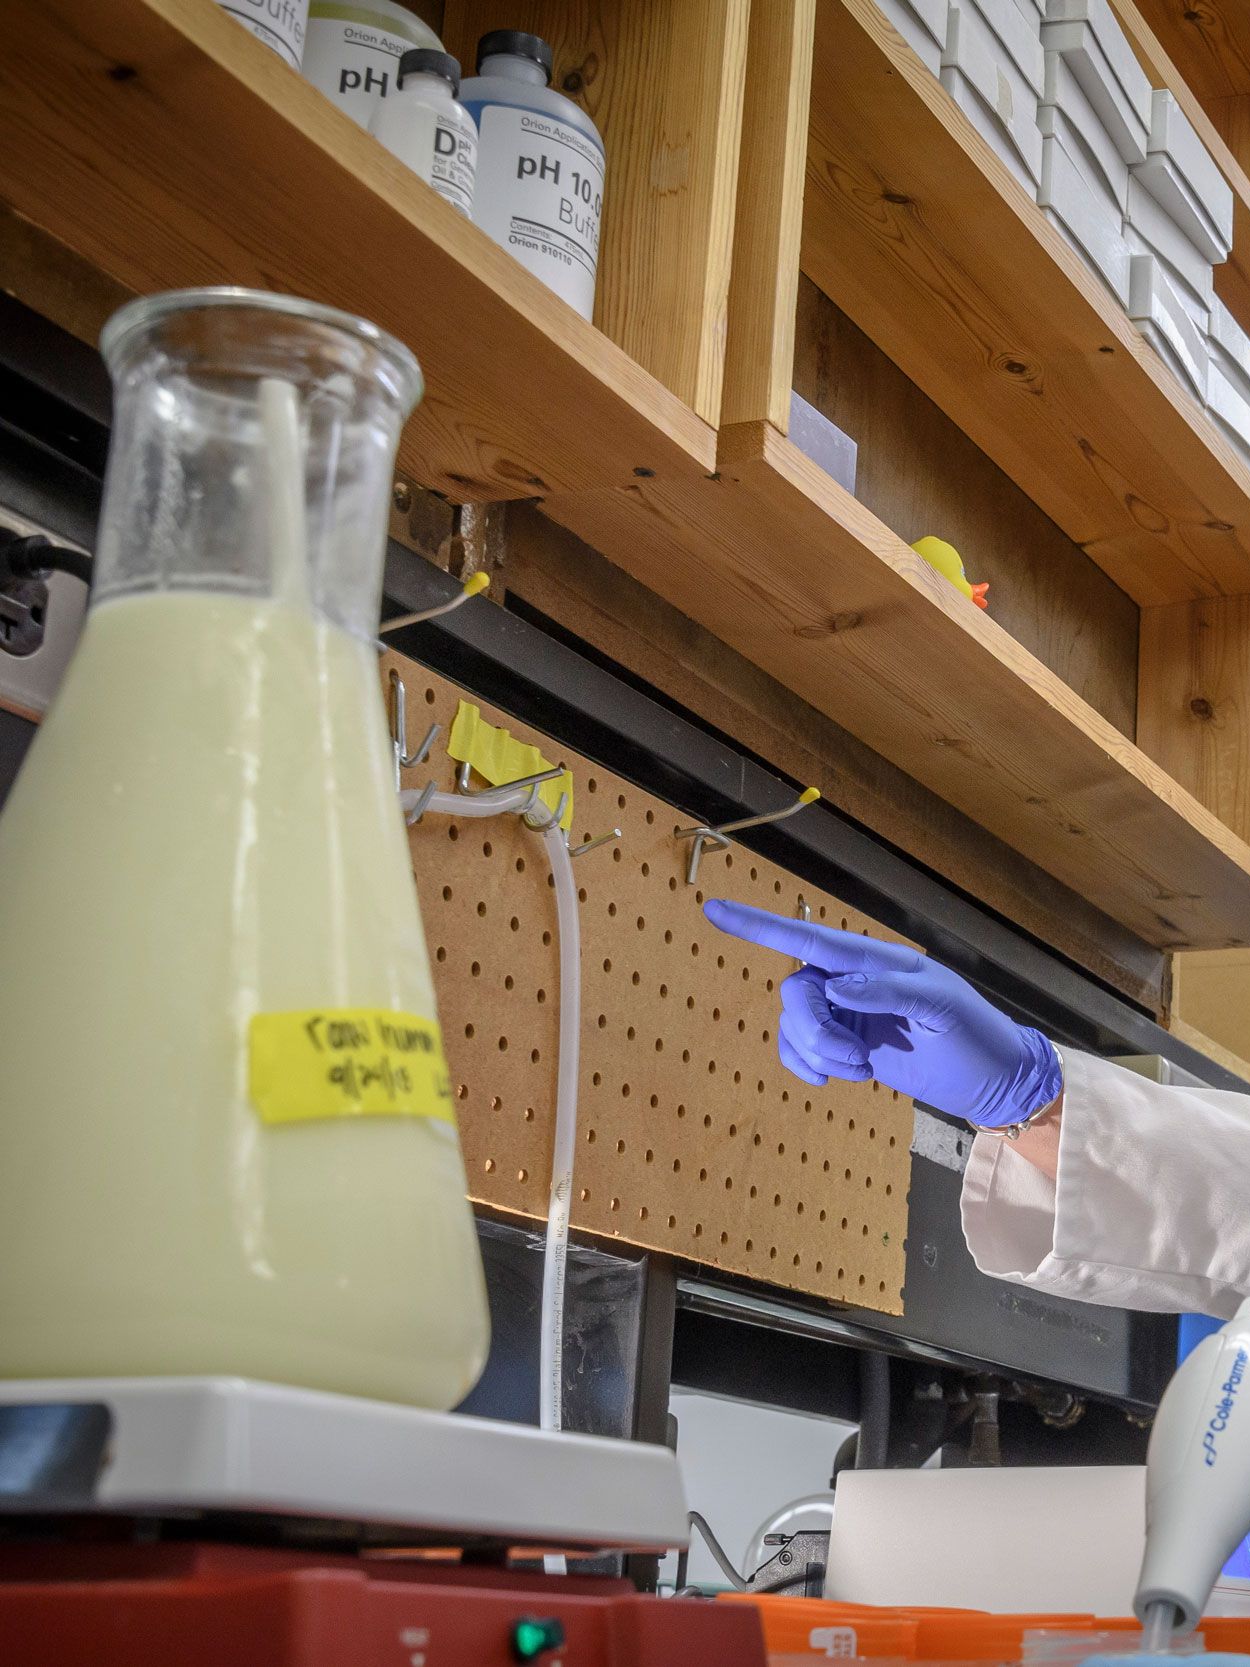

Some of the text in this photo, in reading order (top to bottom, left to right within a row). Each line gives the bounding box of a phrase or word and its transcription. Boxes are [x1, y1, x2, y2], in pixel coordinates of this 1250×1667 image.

[246, 0, 304, 43] uffe
[344, 28, 377, 44] Orion
[339, 66, 389, 98] pH
[521, 117, 551, 133] Orion
[434, 127, 457, 157] D
[517, 154, 561, 186] pH
[571, 172, 602, 218] 10.0
[508, 234, 572, 266] Orion 910110
